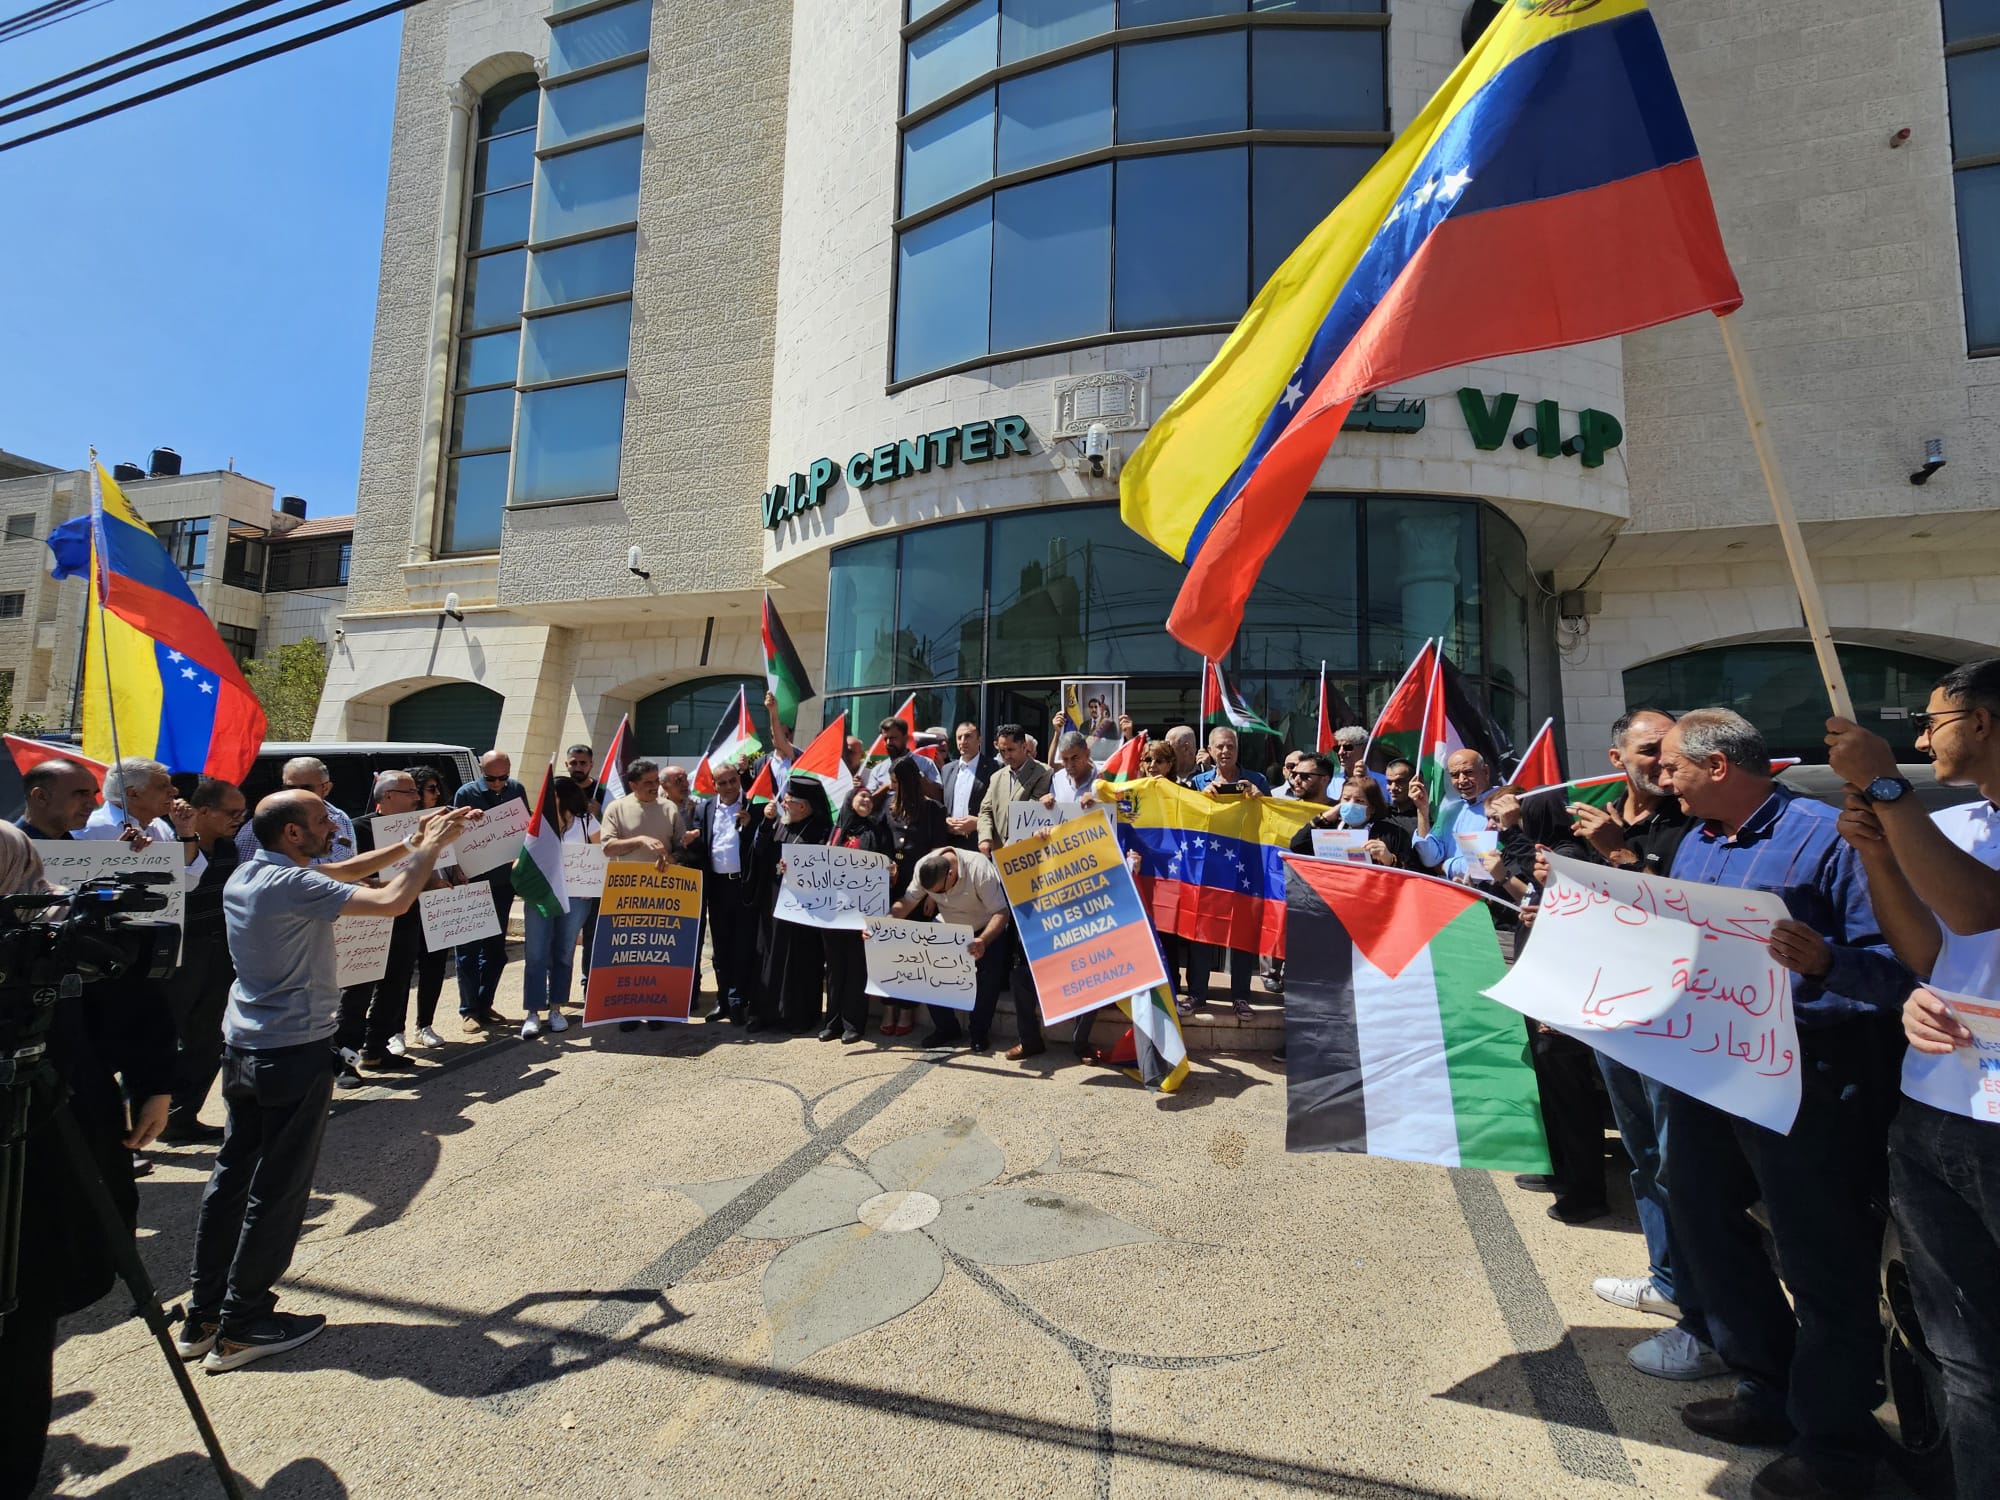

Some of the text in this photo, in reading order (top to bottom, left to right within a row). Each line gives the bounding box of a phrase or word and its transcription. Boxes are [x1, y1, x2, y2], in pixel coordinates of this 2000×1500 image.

[1456, 387, 1624, 468] V.I.P
[760, 414, 1031, 530] V.I.P CENTER
[101, 853, 171, 867] asesinas
[793, 848, 884, 870] الولايات المتحدة
[1003, 824, 1108, 876] DESDE PALESTINA
[608, 874, 637, 888] DESDE
[639, 874, 698, 893] PALESTINA
[832, 871, 847, 891] في
[847, 875, 886, 892] شريك
[1030, 854, 1098, 893] AFIRMAMOS
[616, 897, 681, 911] AFIRMAMOS
[1032, 873, 1110, 913] VENEZUELA
[1544, 879, 1610, 916] فنزويلا
[611, 915, 681, 930] VENEZUELA
[1041, 893, 1114, 932] NO ES UNA
[1664, 888, 1772, 944] تحية
[611, 933, 676, 946] NO ES UNA
[911, 926, 966, 947] فلسطين
[1052, 914, 1118, 951] AMENAZA
[611, 951, 670, 964] AMENAZA
[891, 949, 972, 973] ذات العدو
[1070, 947, 1115, 973] ES UNA
[616, 975, 657, 988] ES UNA
[880, 966, 974, 991] ونفس المصير
[1062, 961, 1136, 997] ESPERANZA
[1671, 958, 1787, 1021] الصديقة
[604, 993, 669, 1007] ESPERANZA
[1690, 1021, 1794, 1076] والعار
